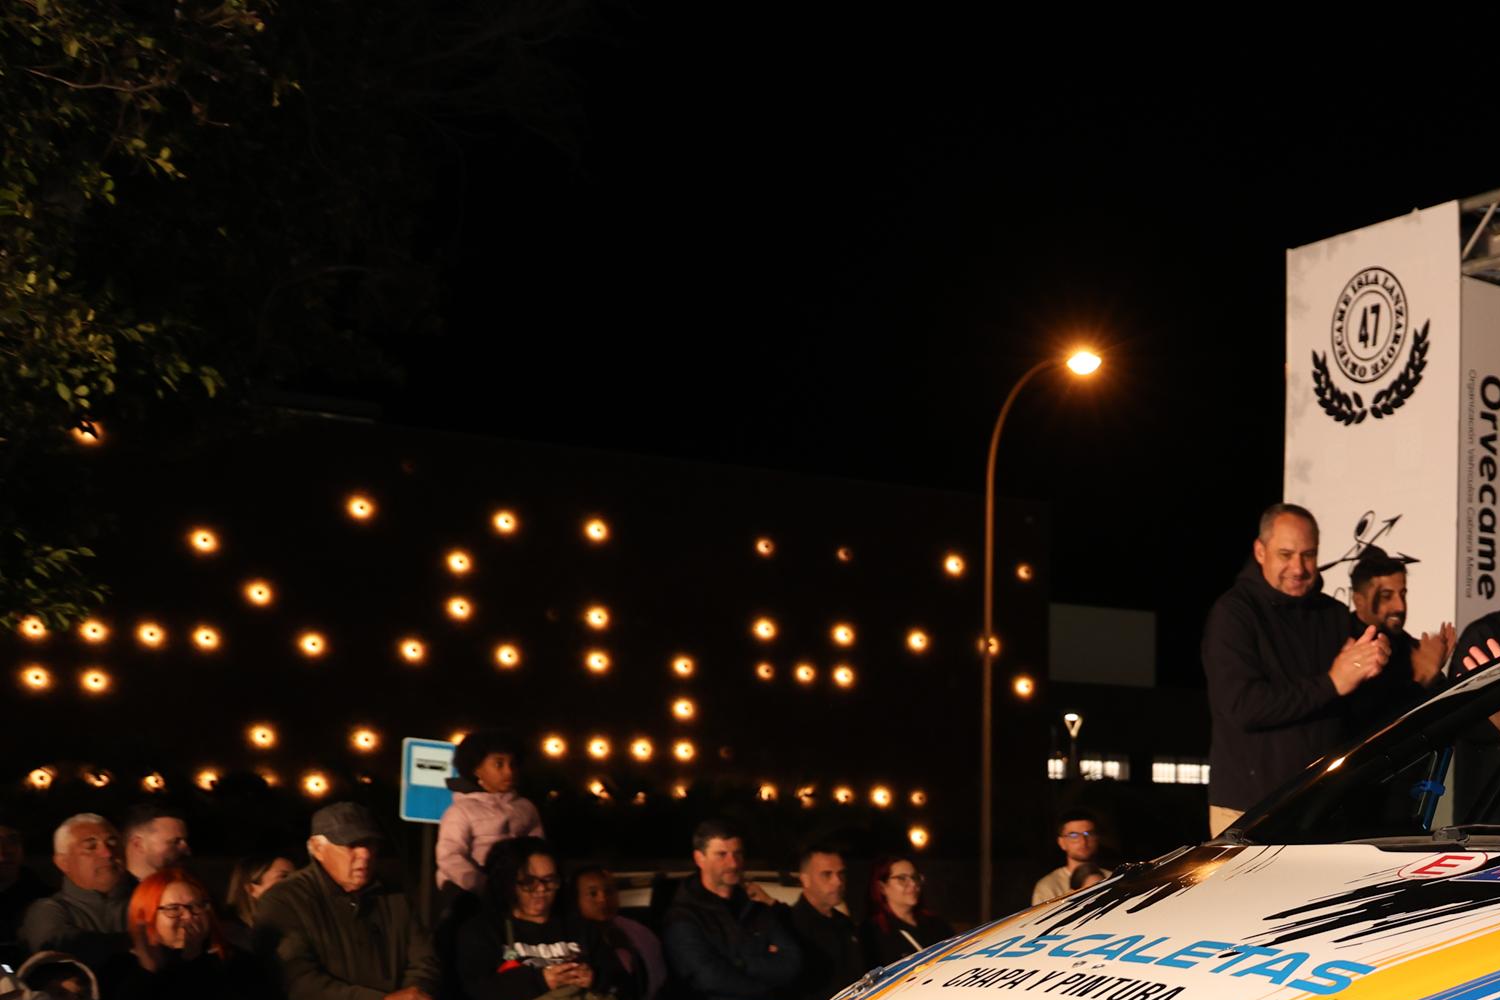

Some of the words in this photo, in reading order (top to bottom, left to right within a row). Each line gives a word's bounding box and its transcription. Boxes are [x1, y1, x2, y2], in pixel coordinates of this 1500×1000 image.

[1358, 303, 1381, 349] 47
[1410, 855, 1476, 875] E
[942, 967, 1040, 990] CHAPA
[1025, 971, 1065, 991] Y
